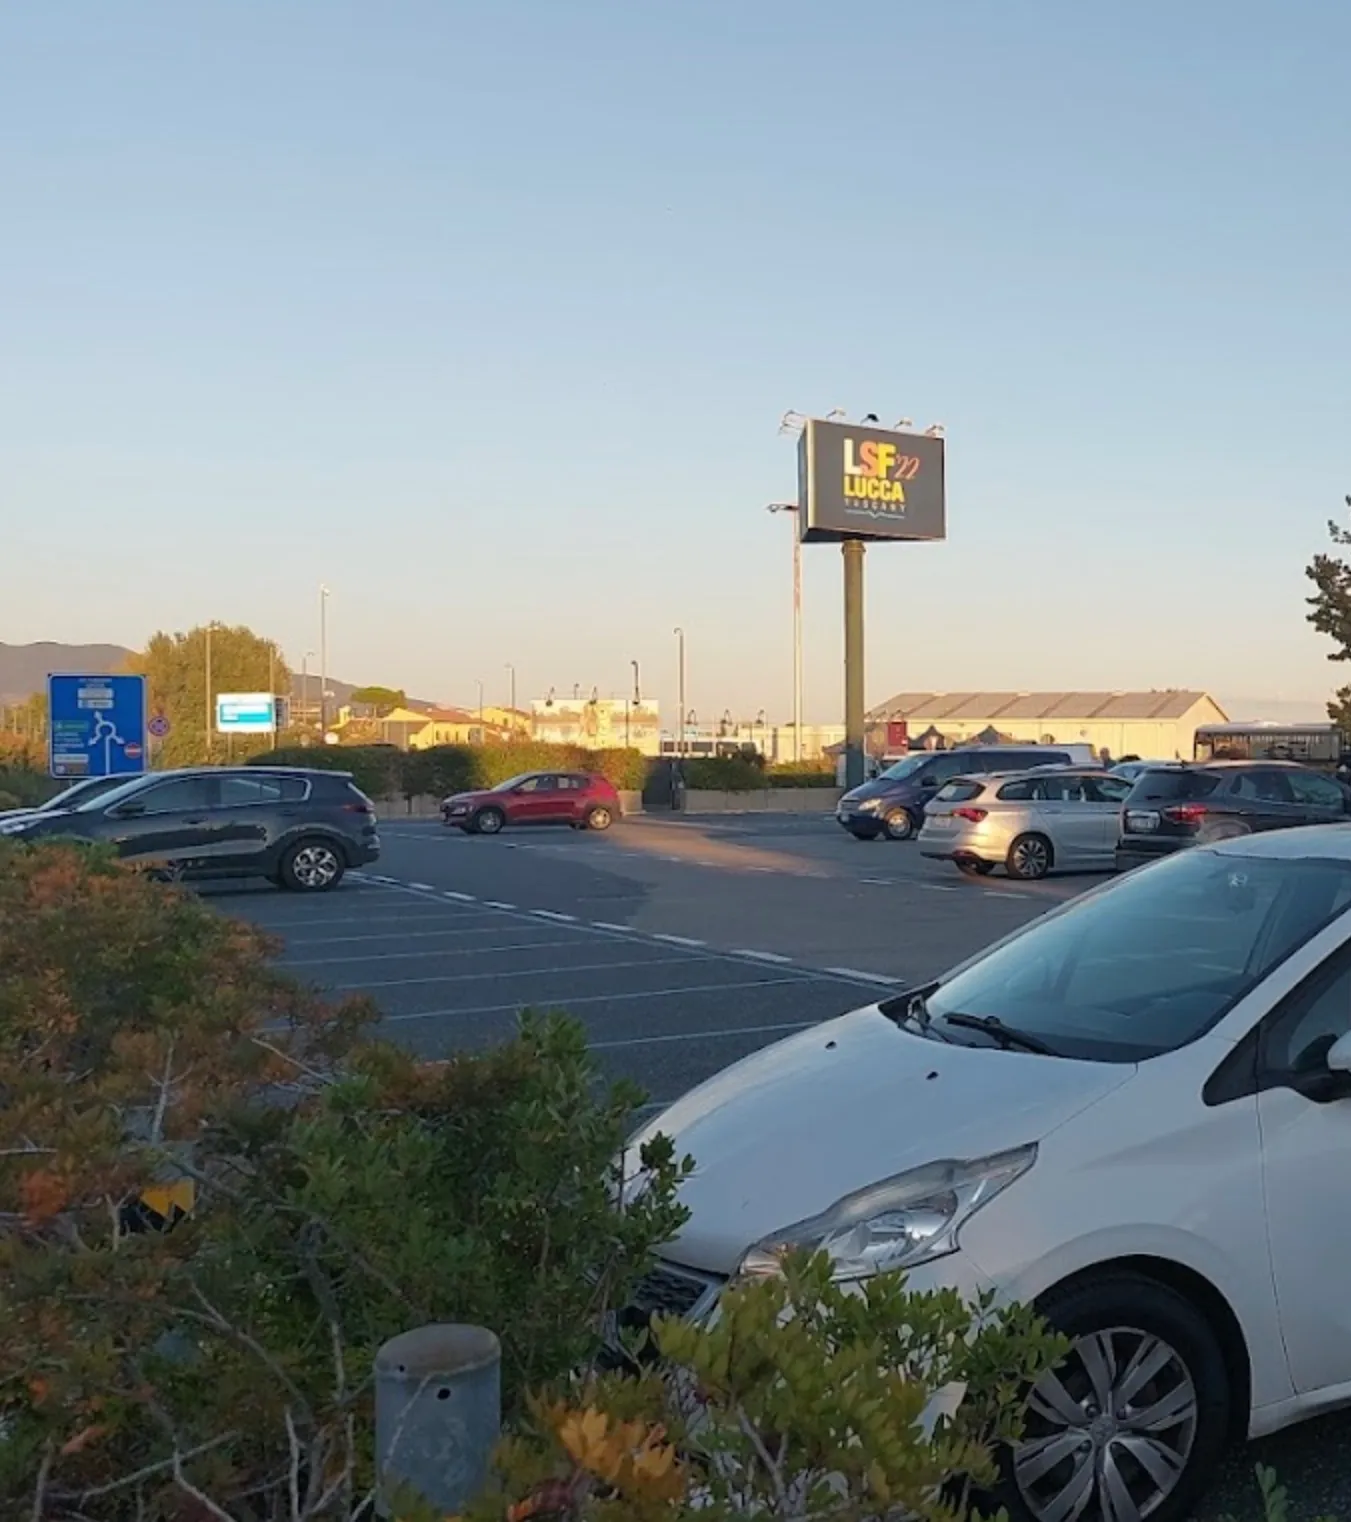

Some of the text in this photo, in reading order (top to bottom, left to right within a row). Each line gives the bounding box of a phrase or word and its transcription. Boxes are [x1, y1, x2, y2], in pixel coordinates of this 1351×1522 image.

[843, 438, 896, 478] LSF
[844, 475, 905, 502] LUCCA
[844, 498, 906, 512] TUSCANY
